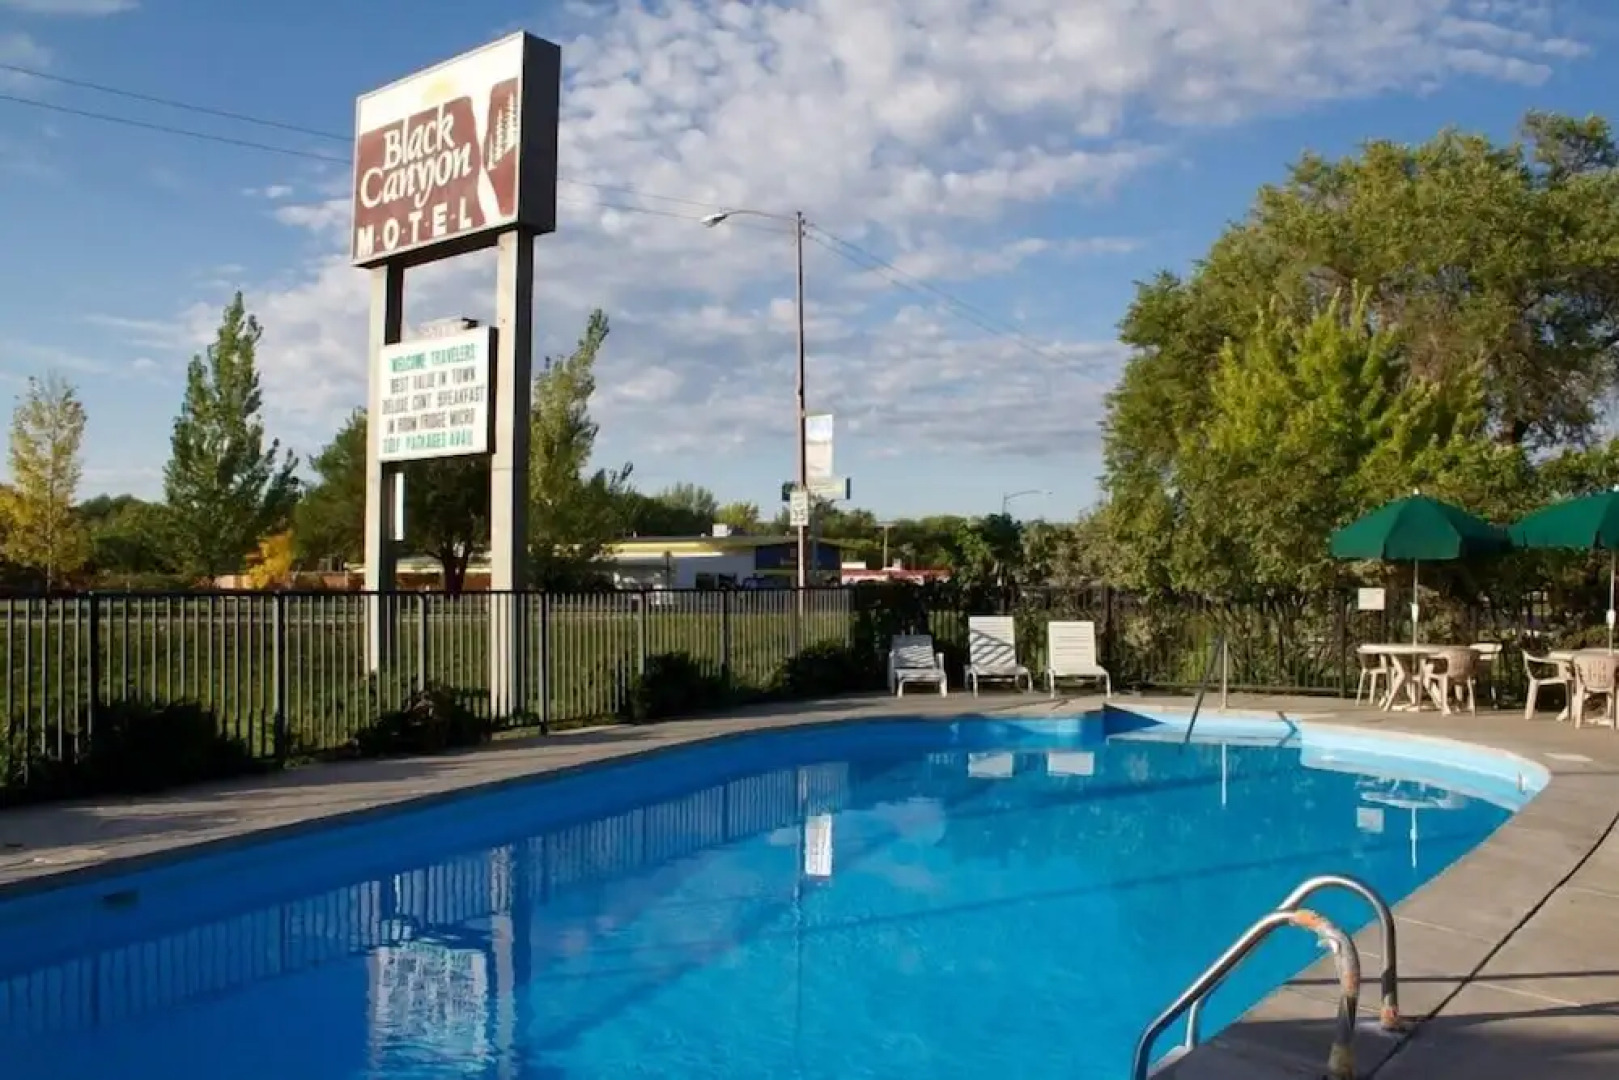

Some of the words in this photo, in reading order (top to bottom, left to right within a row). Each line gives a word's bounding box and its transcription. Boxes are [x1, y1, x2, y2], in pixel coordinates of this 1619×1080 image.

[383, 105, 455, 170] Black
[361, 143, 472, 209] Canyon
[391, 353, 426, 372] WELCOME
[432, 344, 477, 364] TRAVELERS
[391, 377, 408, 394] BEST
[439, 372, 447, 386] IN
[453, 368, 476, 384] TOWN
[438, 386, 485, 407] BREAKFAST
[398, 418, 417, 432] ROOM
[406, 432, 447, 450] PACKAGES
[451, 429, 473, 447] AVAIL
